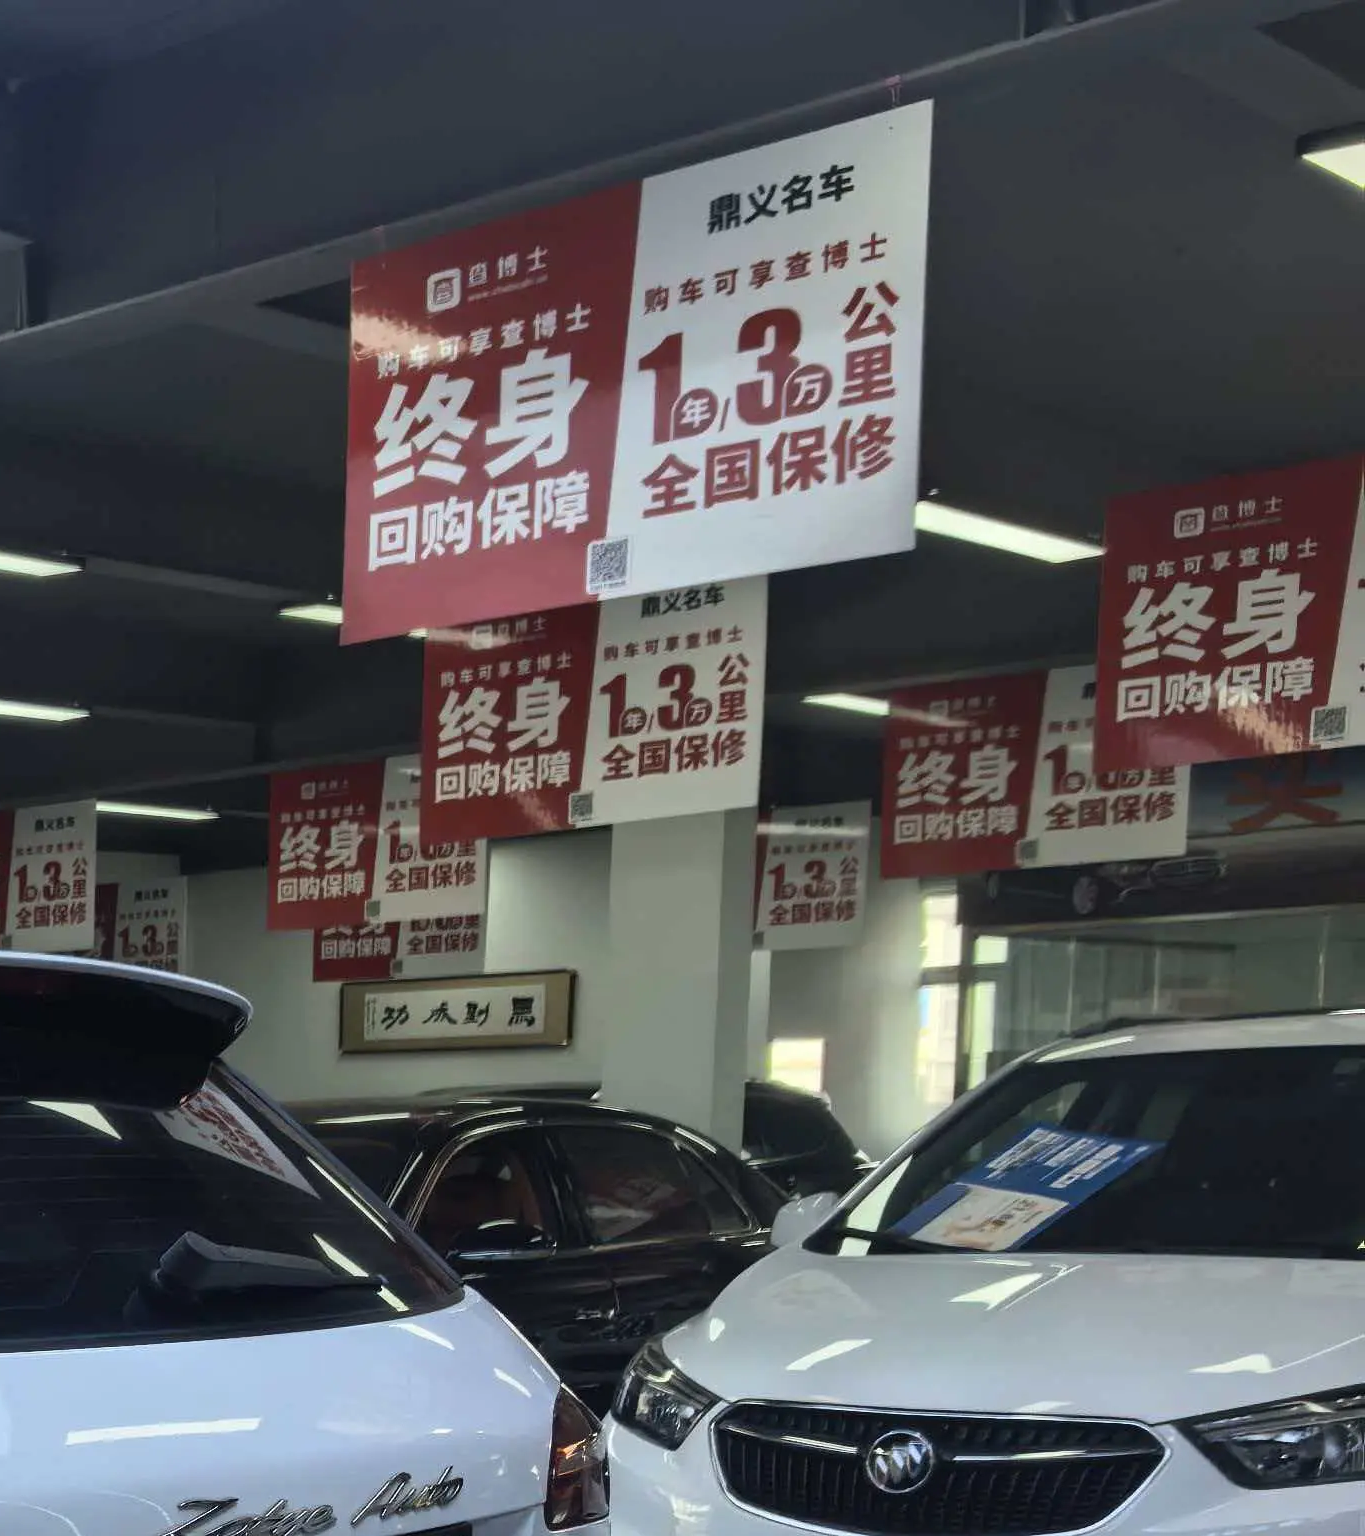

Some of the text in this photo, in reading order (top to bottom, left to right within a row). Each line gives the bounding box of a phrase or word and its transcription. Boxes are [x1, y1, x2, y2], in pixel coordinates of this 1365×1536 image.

[707, 164, 855, 234] 鼎义名车
[643, 232, 888, 316] 购车可享查博士
[377, 302, 592, 379] 购车可享查博士
[373, 348, 589, 499] 终身
[641, 414, 896, 519] 全国保修
[368, 470, 590, 572] 回购保障
[1127, 538, 1318, 584] 购车可享查博士
[641, 583, 725, 618] 鼎义名车
[1121, 568, 1316, 669] 终身
[604, 624, 744, 661] 购车可享查博士
[441, 652, 573, 688] 购车可享查博士
[1116, 656, 1315, 723] 回购保障
[438, 676, 571, 760] 终身
[435, 751, 571, 803] 回购保障
[601, 728, 747, 783] 全国保修
[895, 744, 1017, 809] 终身
[893, 805, 1018, 845] 回购保障
[1045, 791, 1175, 831] 全国保修
[279, 820, 365, 873] 终身
[277, 870, 366, 904] 回购保障
[385, 862, 477, 893] 全国保修
[16, 903, 87, 930] 全国保修
[769, 900, 857, 926] 全国保修
[351, 1465, 465, 1527] Auto
